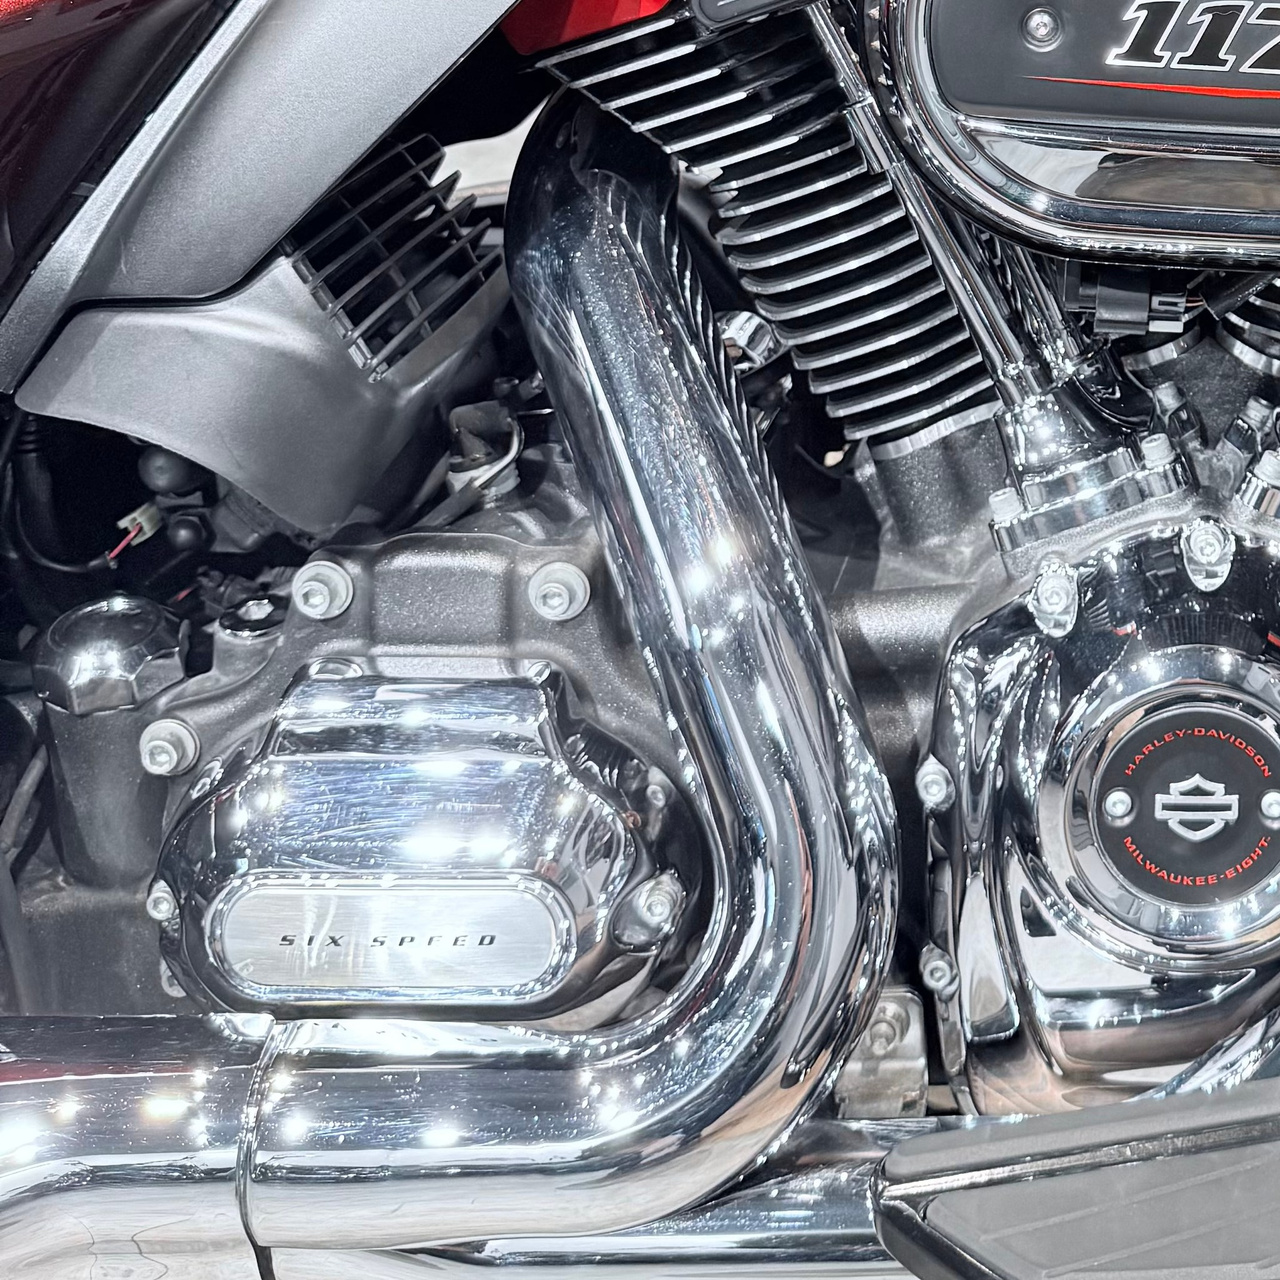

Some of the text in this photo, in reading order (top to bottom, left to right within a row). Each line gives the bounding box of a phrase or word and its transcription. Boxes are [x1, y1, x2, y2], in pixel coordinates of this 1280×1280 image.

[1124, 727, 1272, 778] HARLEY-DAVIDSON
[1123, 835, 1271, 887] MILWAUKEE-EIGHT
[278, 933, 346, 948] SIX
